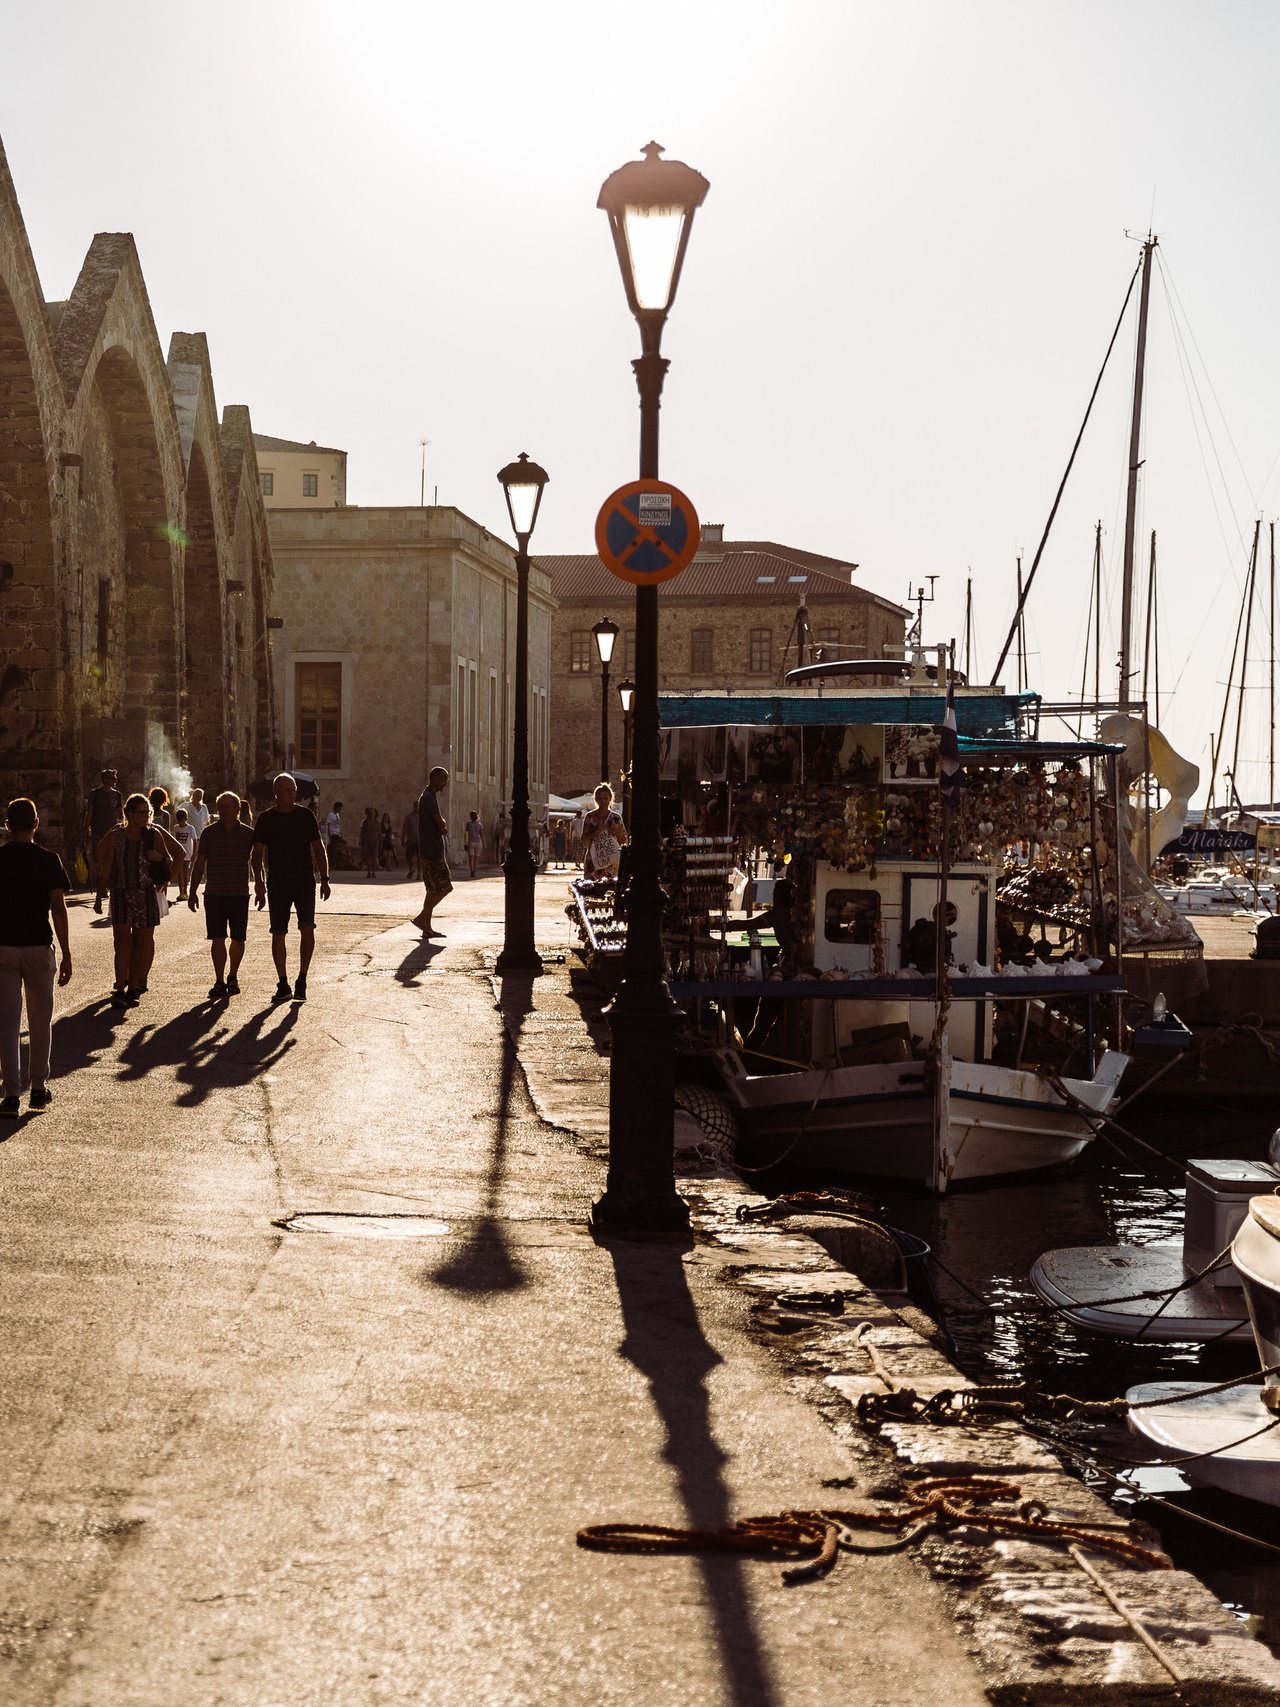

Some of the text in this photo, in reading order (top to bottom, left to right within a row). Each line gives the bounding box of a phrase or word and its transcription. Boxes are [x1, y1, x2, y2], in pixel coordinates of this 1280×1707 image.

[641, 496, 670, 504] ΠΡΟΣΟΧΗ
[641, 510, 670, 518] ΚΙΝΔΥΝΟΣ
[596, 847, 617, 859] MUSE
[597, 856, 612, 867] UM
